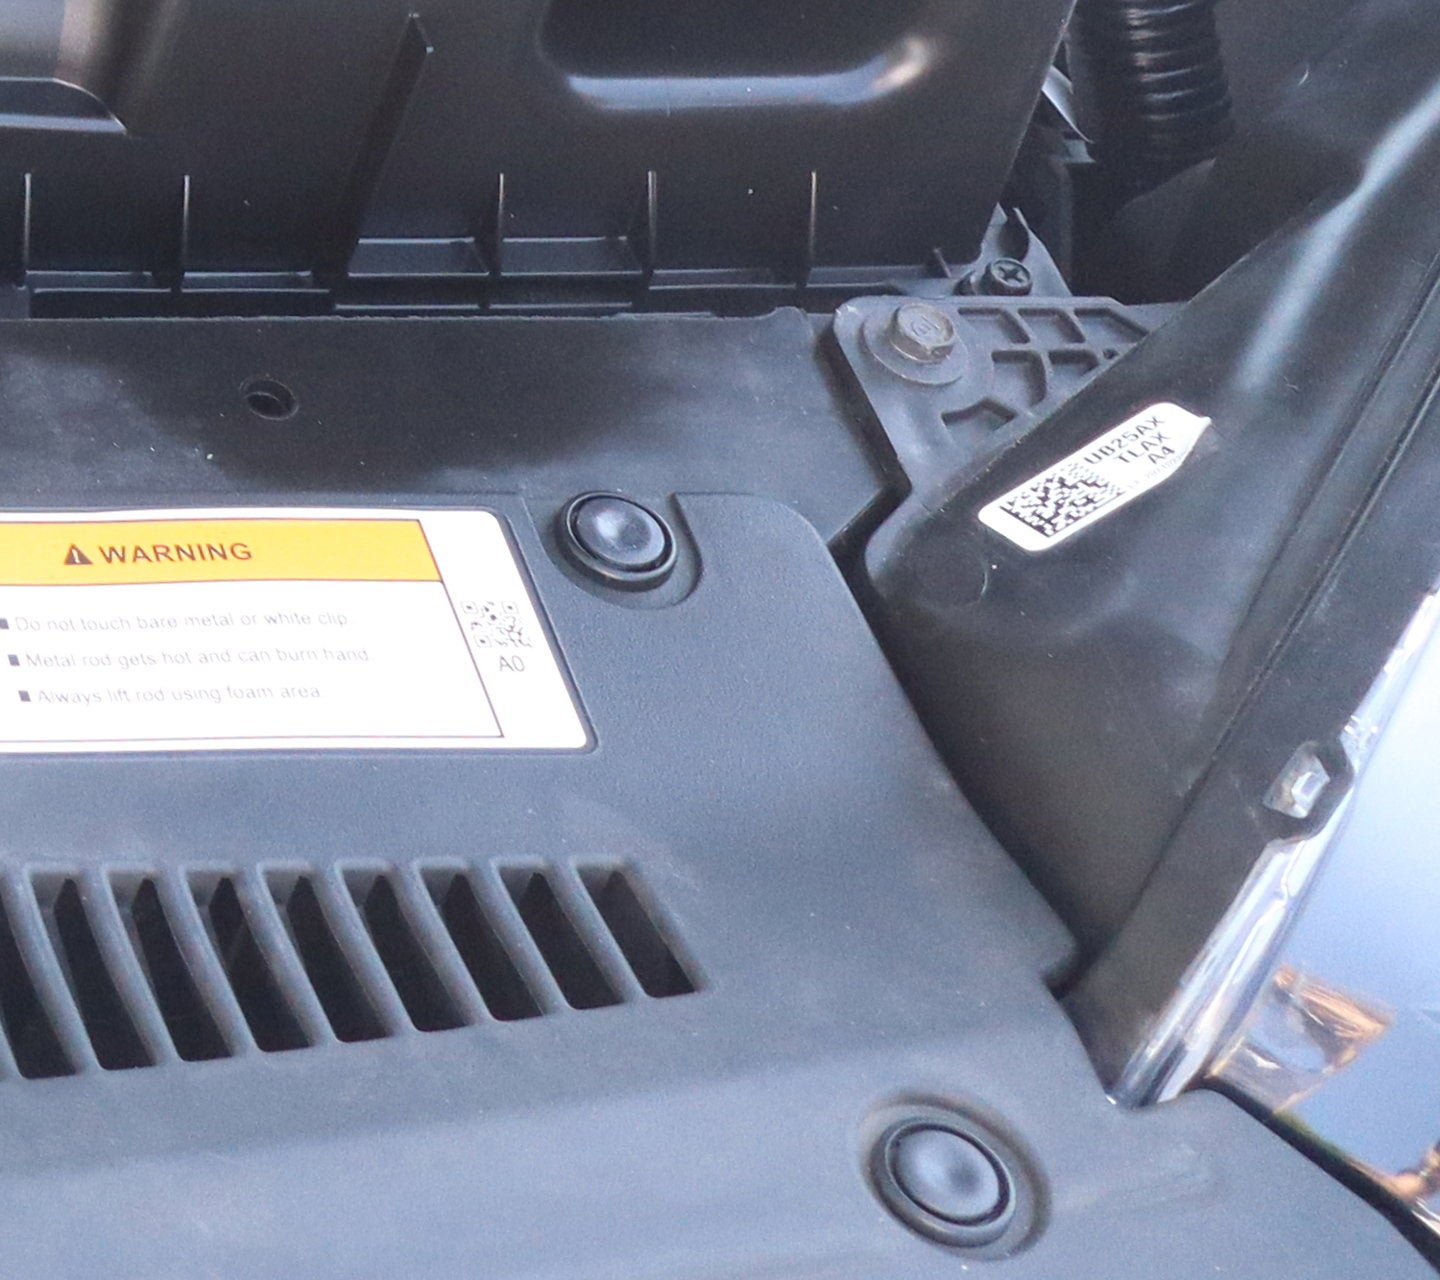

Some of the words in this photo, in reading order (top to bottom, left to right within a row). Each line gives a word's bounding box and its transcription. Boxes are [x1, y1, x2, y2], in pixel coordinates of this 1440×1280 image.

[97, 541, 254, 565] WARNING
[15, 616, 41, 632] Do
[48, 616, 76, 632] not
[80, 615, 130, 631] touch
[137, 614, 178, 630] bare
[184, 613, 234, 629] metal
[240, 613, 257, 627] or
[264, 612, 311, 627] white
[318, 612, 348, 629] clip
[25, 653, 76, 668] Metal
[82, 651, 111, 667] rod
[117, 651, 156, 671] gets
[162, 649, 191, 664] hot
[199, 649, 231, 664] and
[238, 649, 271, 663] can
[276, 648, 318, 662] burn
[324, 647, 369, 662] hand
[38, 687, 102, 707] Always
[108, 686, 131, 704] lift
[136, 686, 166, 703] rod
[171, 686, 221, 704] using
[227, 684, 275, 700] foam
[280, 683, 320, 699] area
